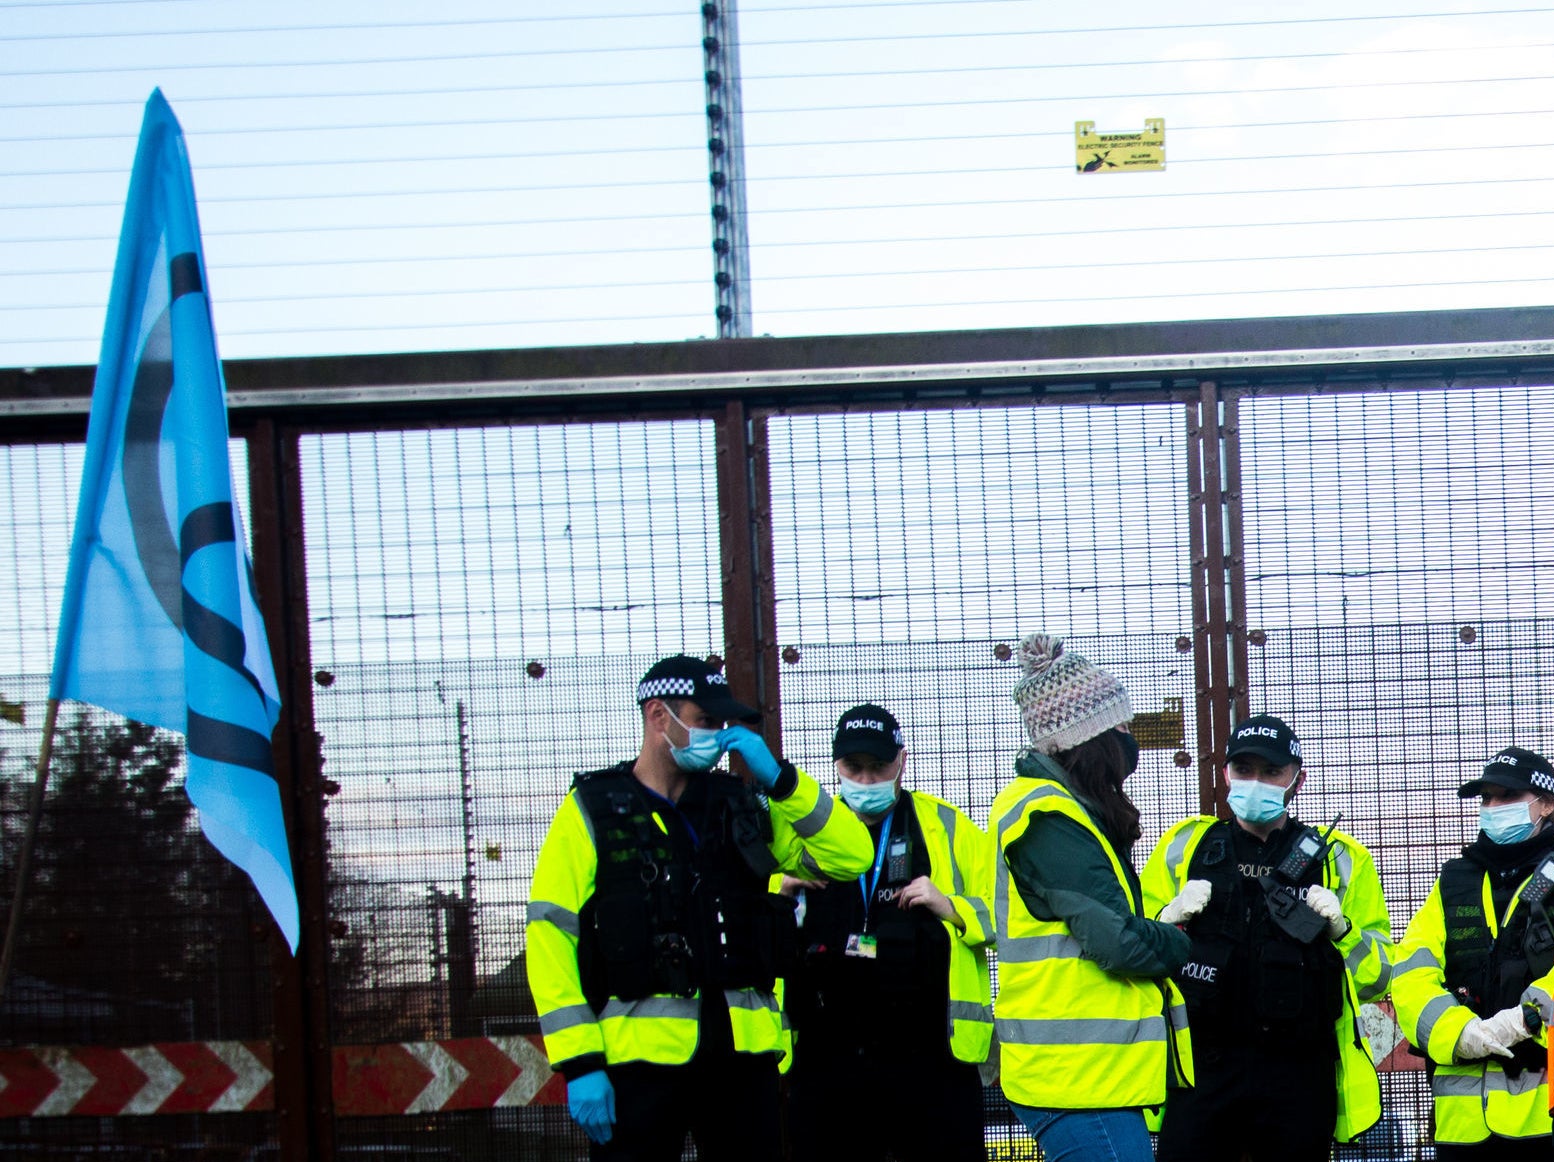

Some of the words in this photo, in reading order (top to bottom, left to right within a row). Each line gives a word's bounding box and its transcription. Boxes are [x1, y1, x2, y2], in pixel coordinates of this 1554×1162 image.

[706, 674, 728, 685] POL
[846, 719, 884, 731] POLICE
[1237, 726, 1278, 739] POLICE
[1182, 962, 1218, 982] POLICE
